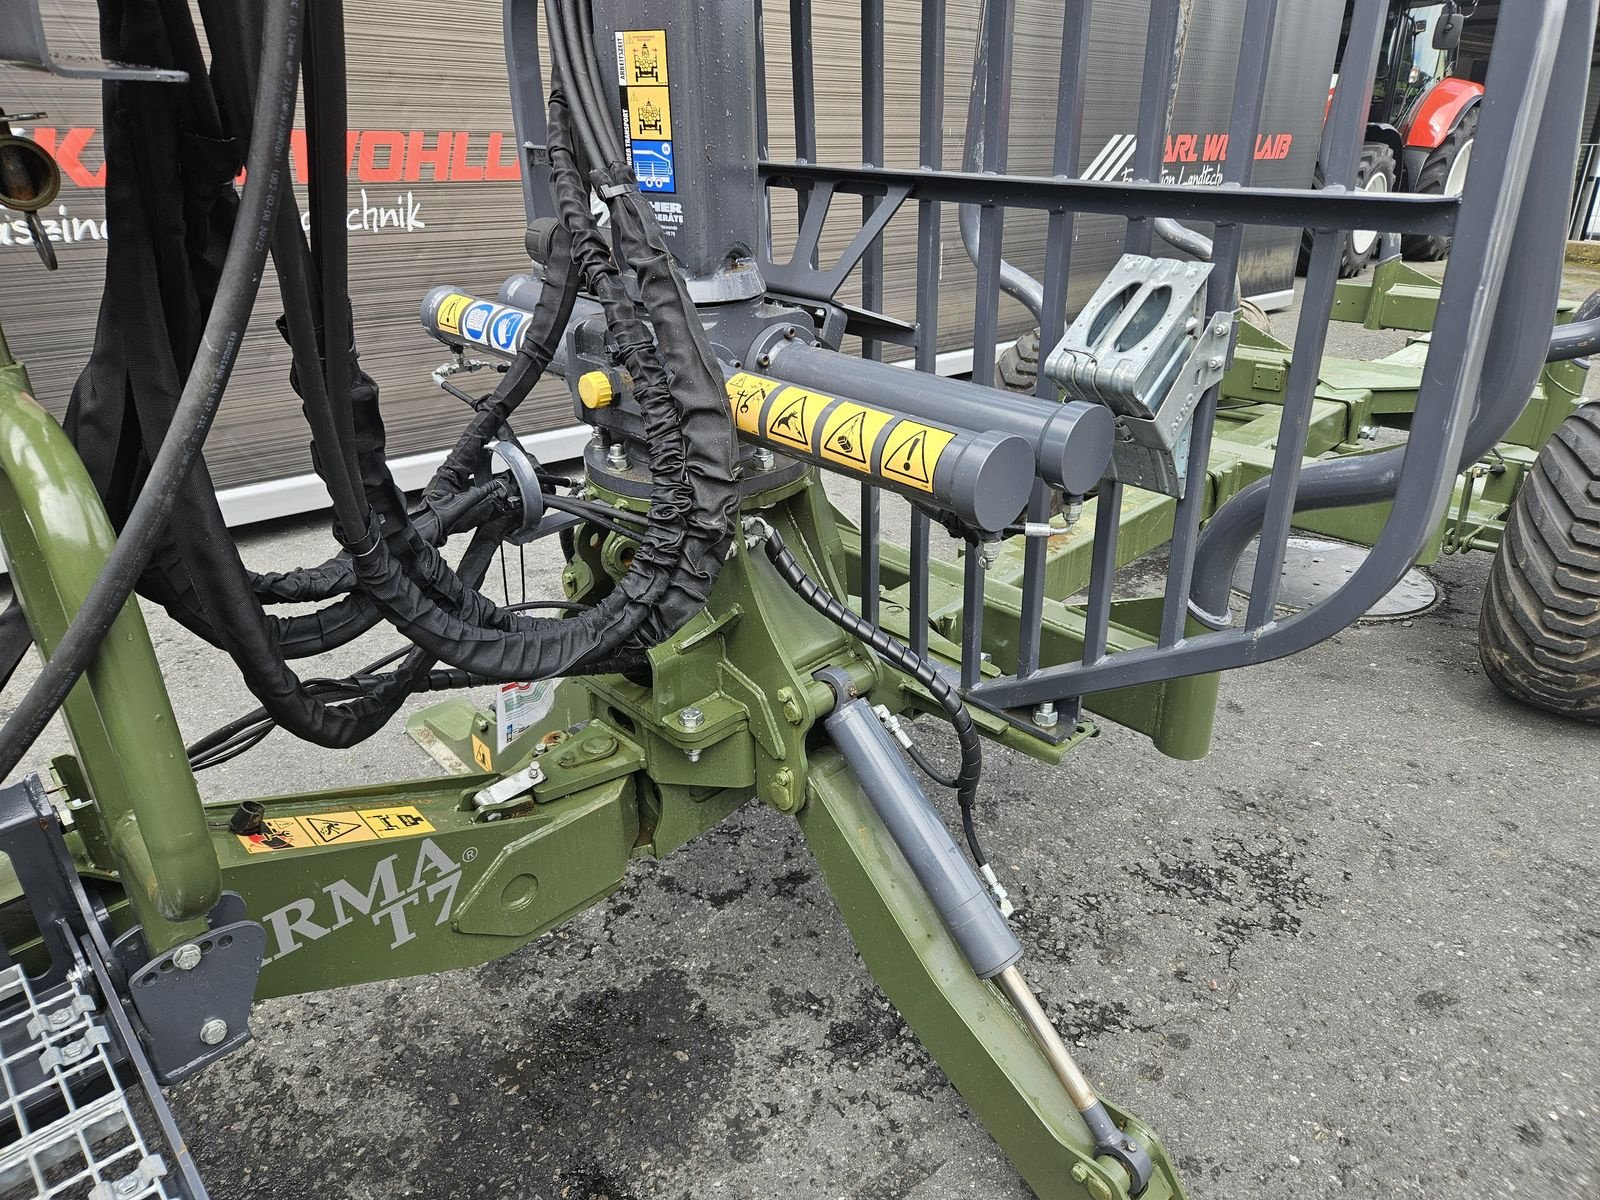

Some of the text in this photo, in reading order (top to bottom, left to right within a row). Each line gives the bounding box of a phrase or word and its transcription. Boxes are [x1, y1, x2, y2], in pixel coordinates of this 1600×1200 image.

[617, 38, 625, 80] ARBEITSZEIT
[622, 109, 633, 166] NDER TRANSPORT
[1162, 134, 1198, 163] ARL
[648, 201, 683, 214] HER
[261, 838, 461, 968] RMA
[371, 869, 463, 950] T7
